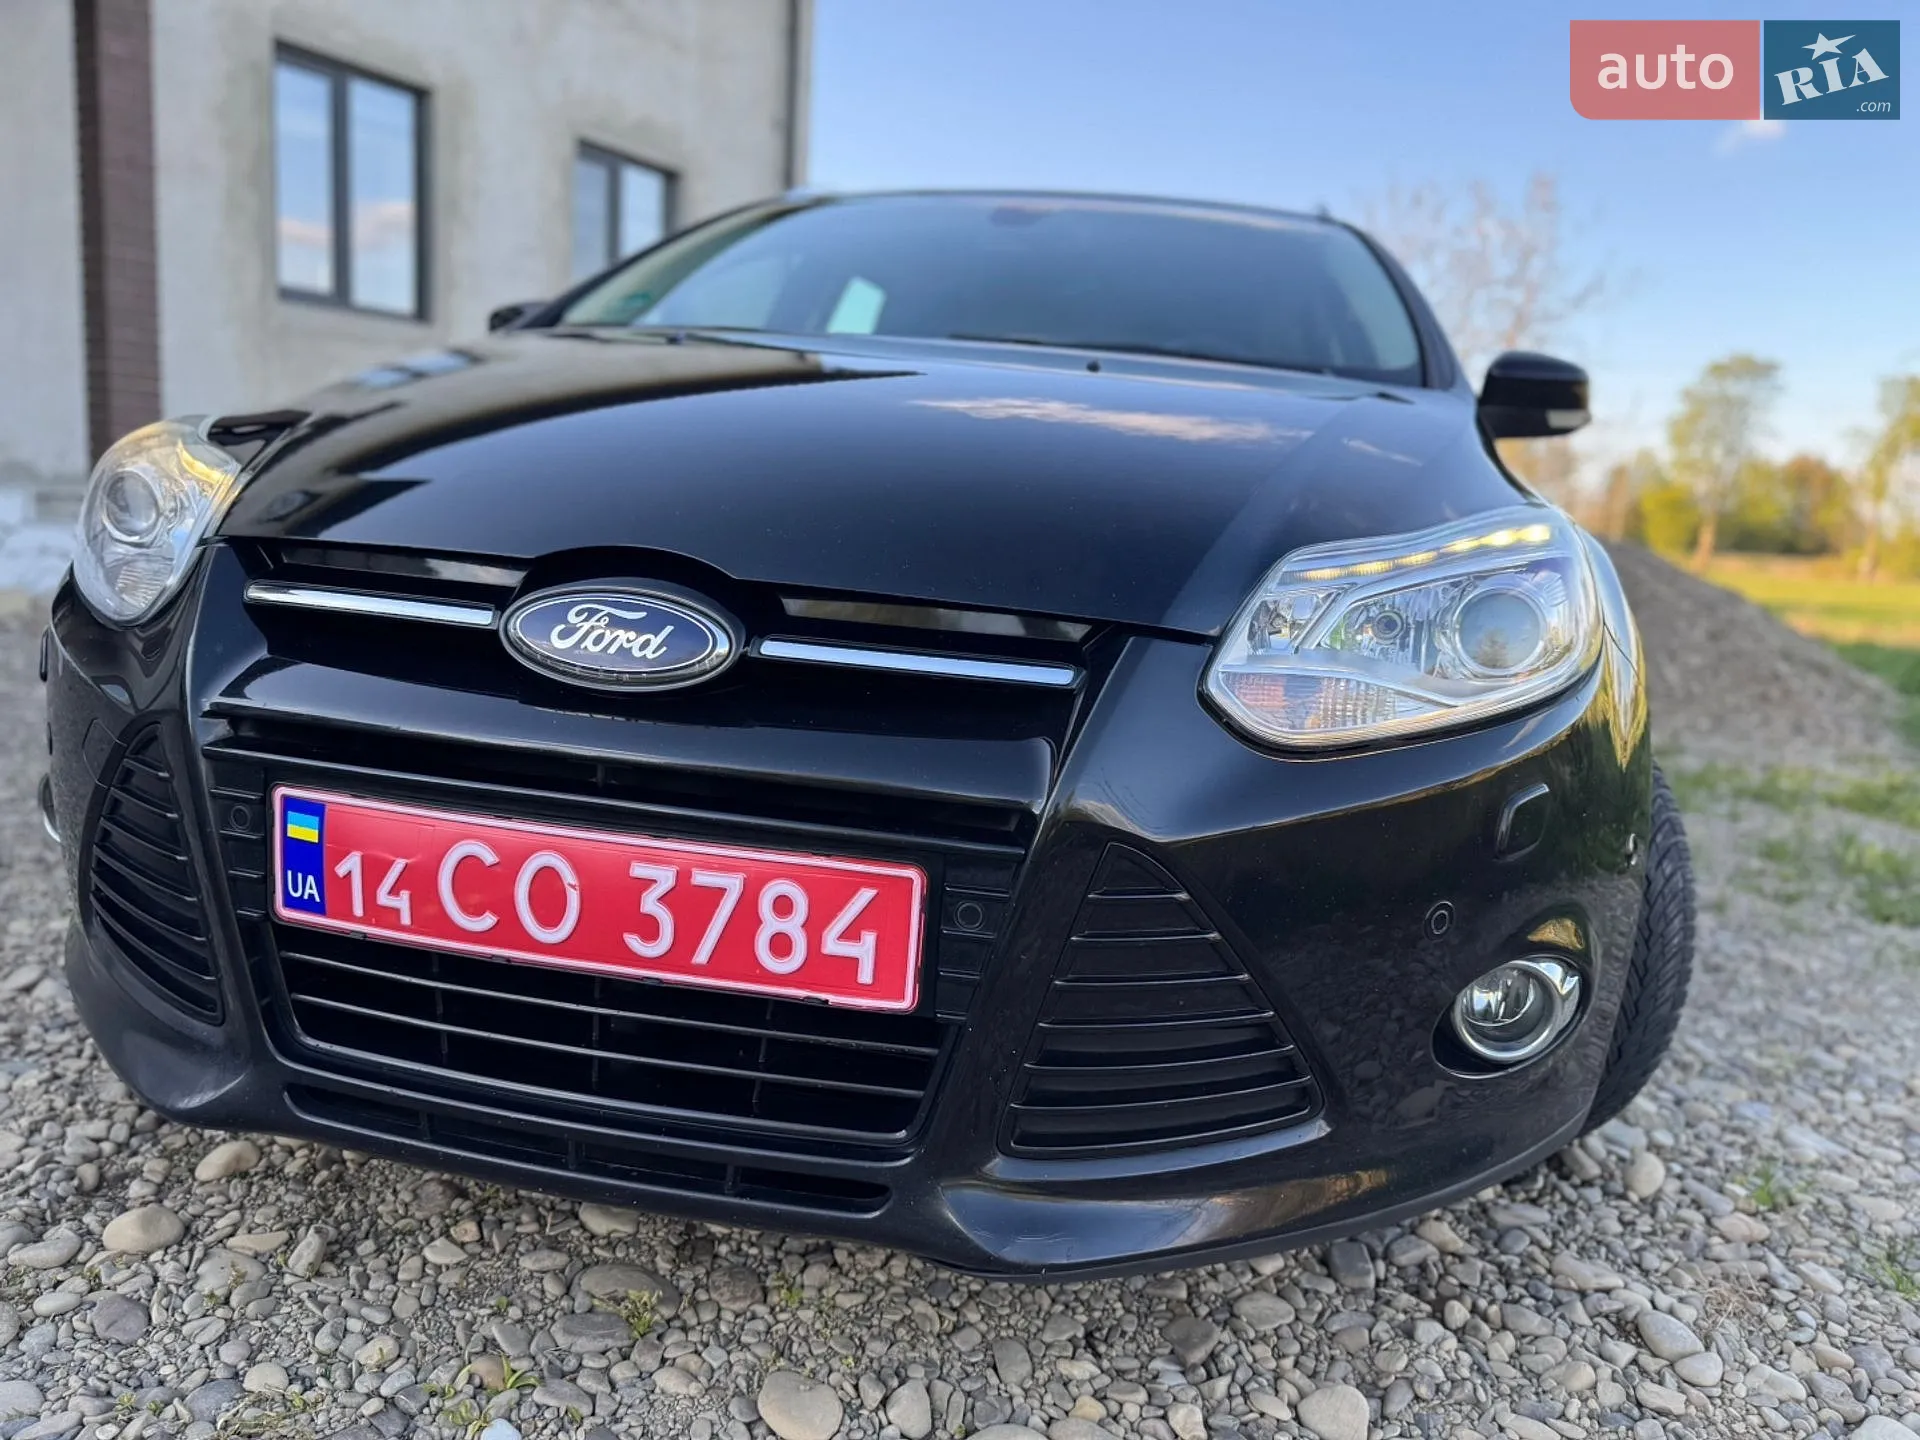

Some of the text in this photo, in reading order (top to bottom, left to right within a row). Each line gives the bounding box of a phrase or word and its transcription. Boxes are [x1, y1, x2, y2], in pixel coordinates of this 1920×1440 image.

[550, 603, 675, 661] Ford
[286, 869, 322, 904] UA
[333, 850, 412, 927] 14
[622, 861, 878, 985] 3784
